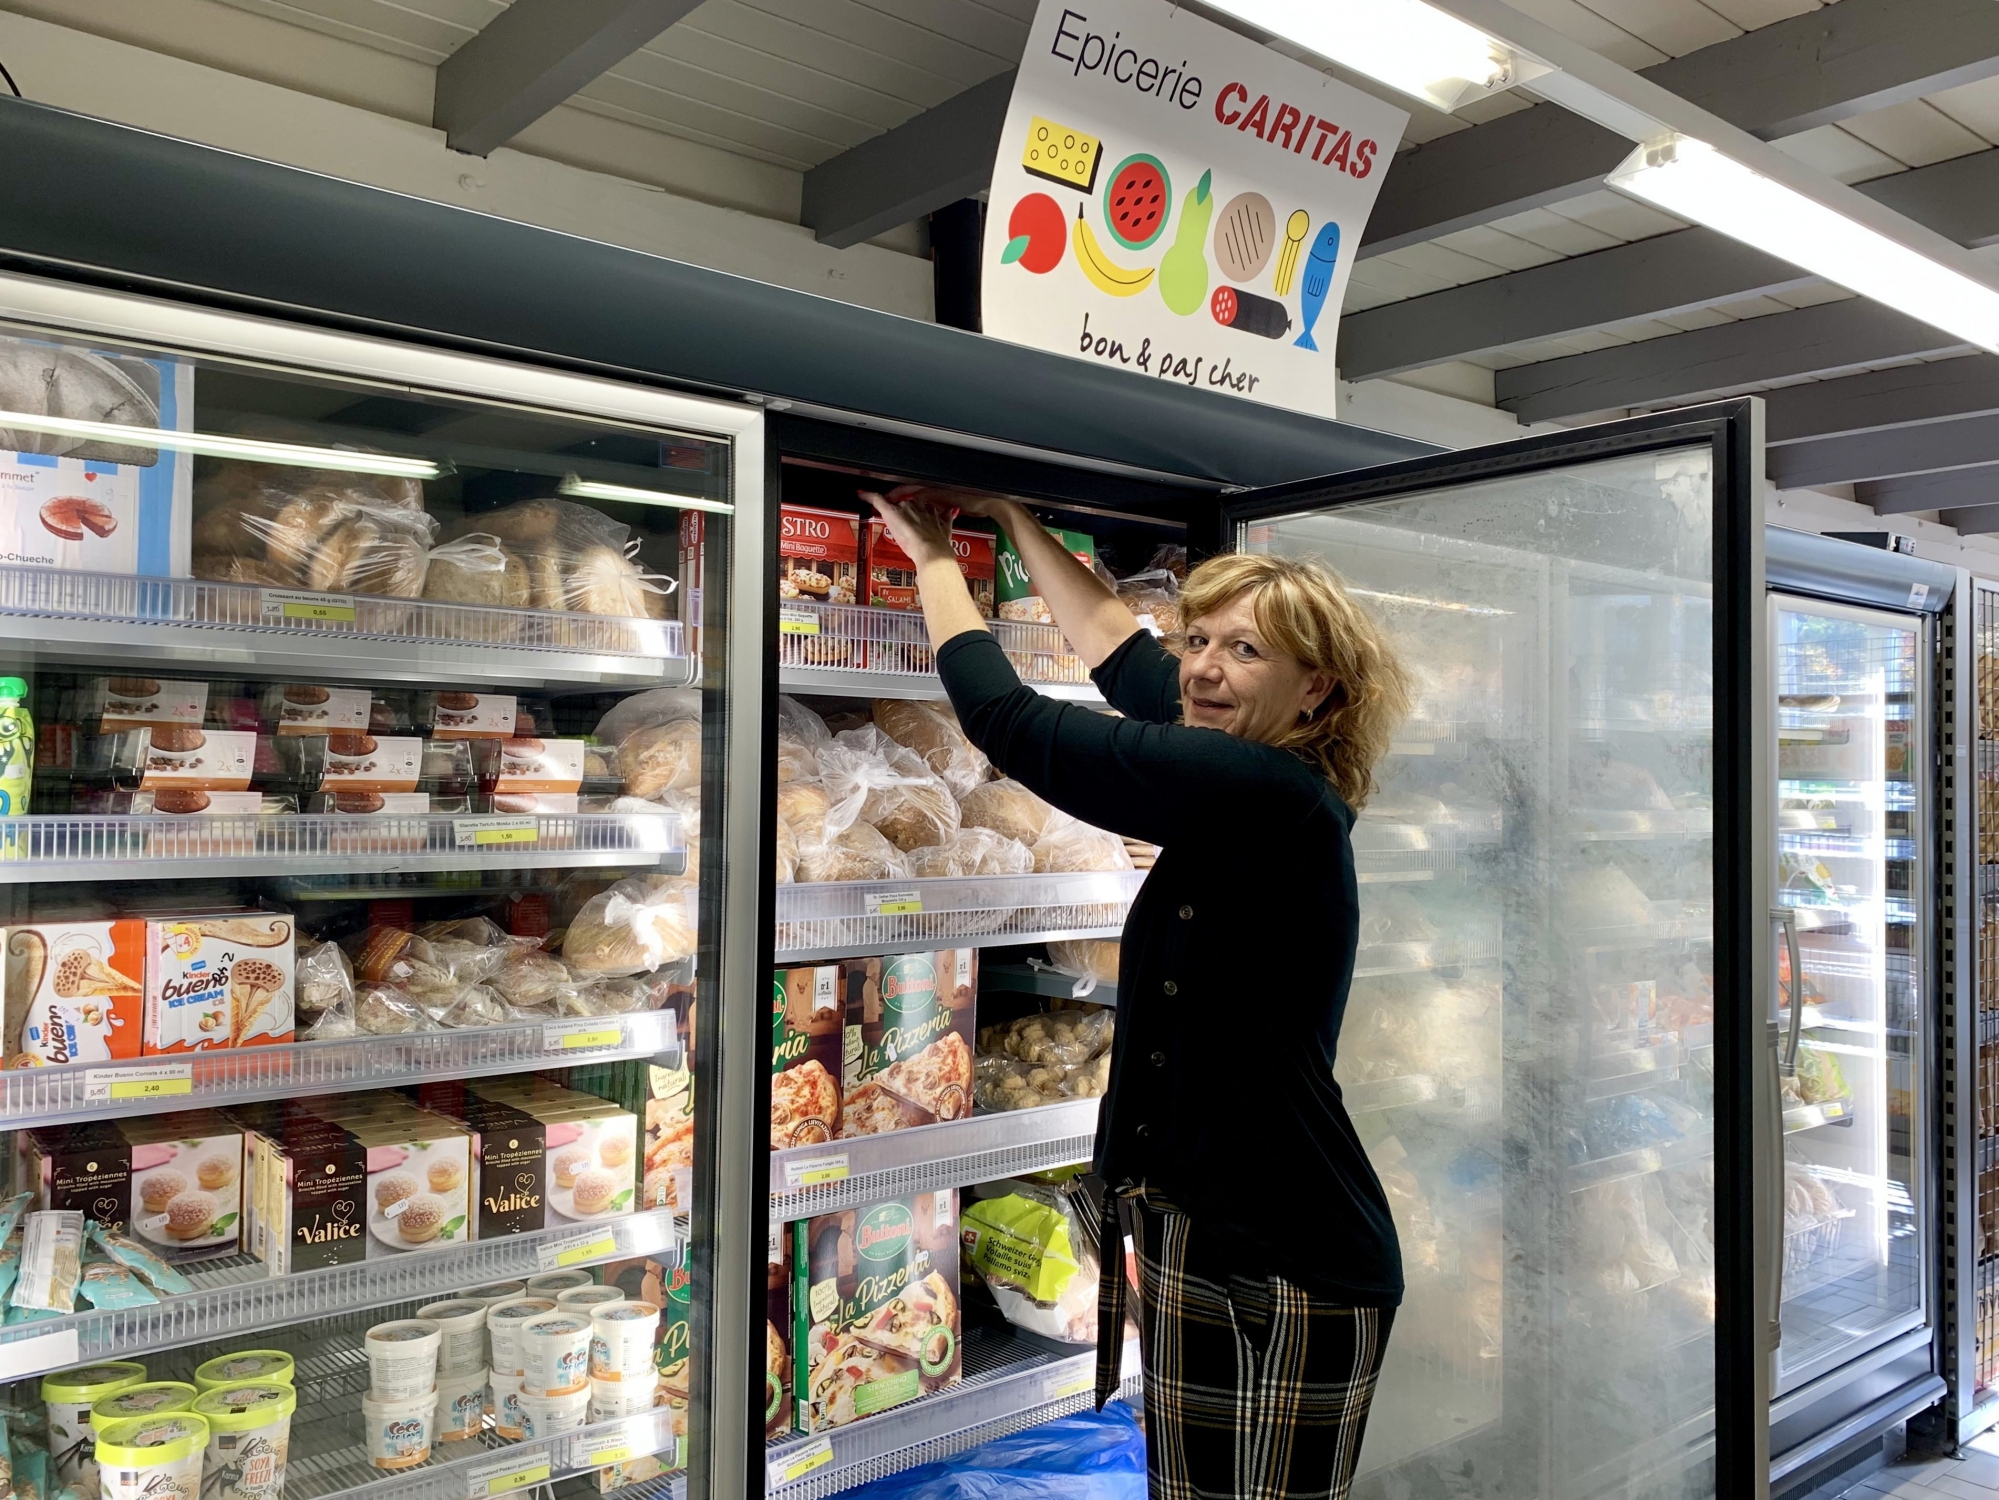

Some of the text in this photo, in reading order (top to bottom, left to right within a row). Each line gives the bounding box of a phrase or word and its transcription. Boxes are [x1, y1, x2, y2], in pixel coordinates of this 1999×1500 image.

[1051, 9, 1378, 180] Epicerie CARITAS
[1079, 312, 1260, 394] bon & pas cher
[781, 516, 830, 539] STRO
[796, 543, 824, 554] Baguette
[162, 975, 229, 1001] bueno
[885, 974, 936, 999] Buitoni
[168, 989, 225, 1009] ICE CREAM
[40, 1022, 50, 1048] kinder
[857, 1044, 881, 1081] La
[880, 1005, 953, 1061] Pizzeria
[500, 1149, 542, 1159] Tropéziennes
[75, 1171, 127, 1183] Tropéziennes
[315, 1174, 363, 1185] Tropéziennes
[484, 1185, 540, 1214] Valice
[297, 1214, 360, 1245] Valice
[860, 1218, 912, 1249] Buitoni
[985, 1244, 1012, 1262] Volaille
[988, 1236, 1028, 1258] Schweizer
[834, 1298, 856, 1335] La
[855, 1247, 933, 1311] Pizzeria
[867, 1375, 907, 1392] STRACCHINO
[249, 1456, 270, 1471] SOYA
[221, 1470, 240, 1480] Karma
[244, 1468, 272, 1486] FREEZE
